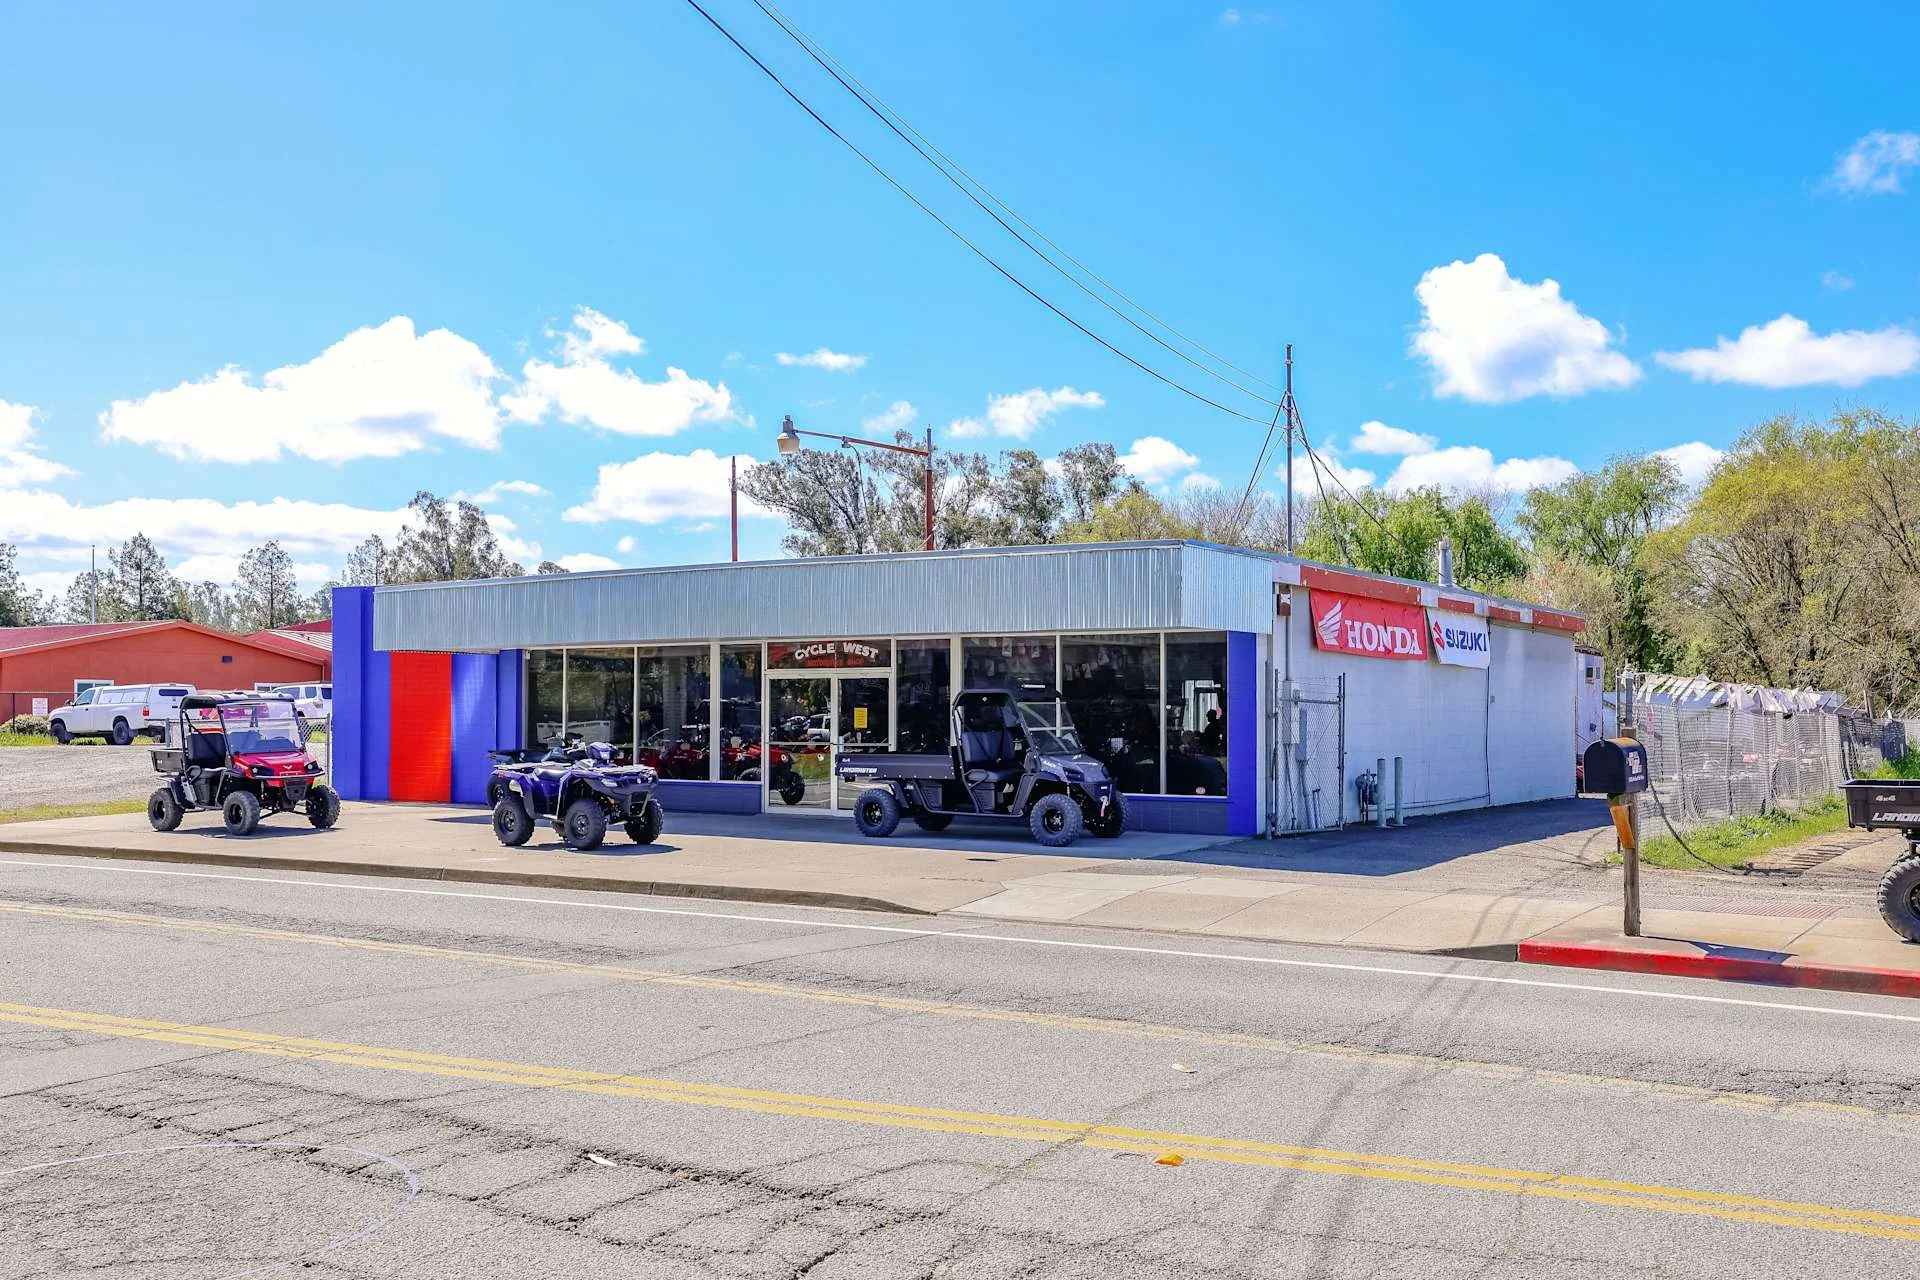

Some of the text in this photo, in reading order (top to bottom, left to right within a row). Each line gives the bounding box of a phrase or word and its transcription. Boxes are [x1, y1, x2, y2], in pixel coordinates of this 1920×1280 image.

[1344, 619, 1422, 655] HONDA
[1445, 628, 1488, 652] SUZUKI
[794, 641, 879, 660] CYCLE WEST
[1875, 794, 1897, 802] 4x4
